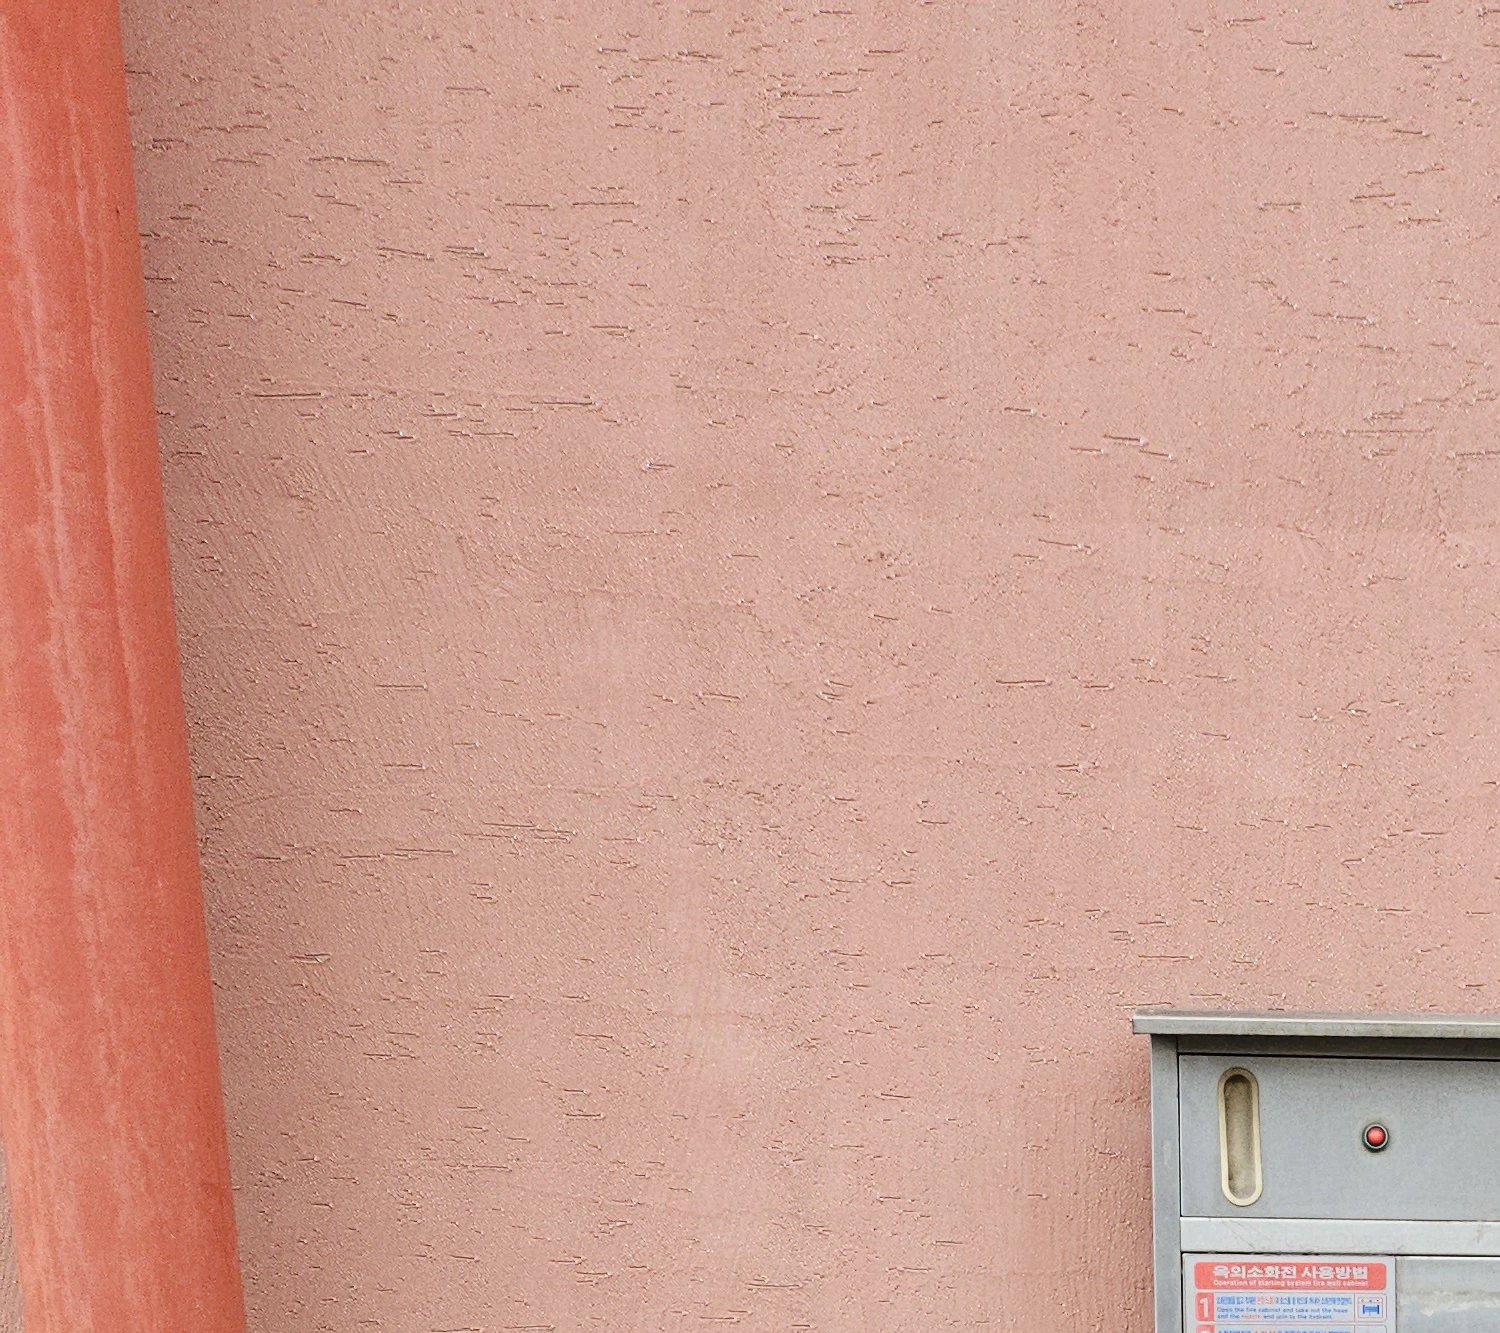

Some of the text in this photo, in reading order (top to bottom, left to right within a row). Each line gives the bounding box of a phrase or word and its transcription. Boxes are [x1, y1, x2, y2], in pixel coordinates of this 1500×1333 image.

[1212, 1265, 1369, 1280] 옥외소화전 사용방법
[1199, 1297, 1209, 1318] 1
